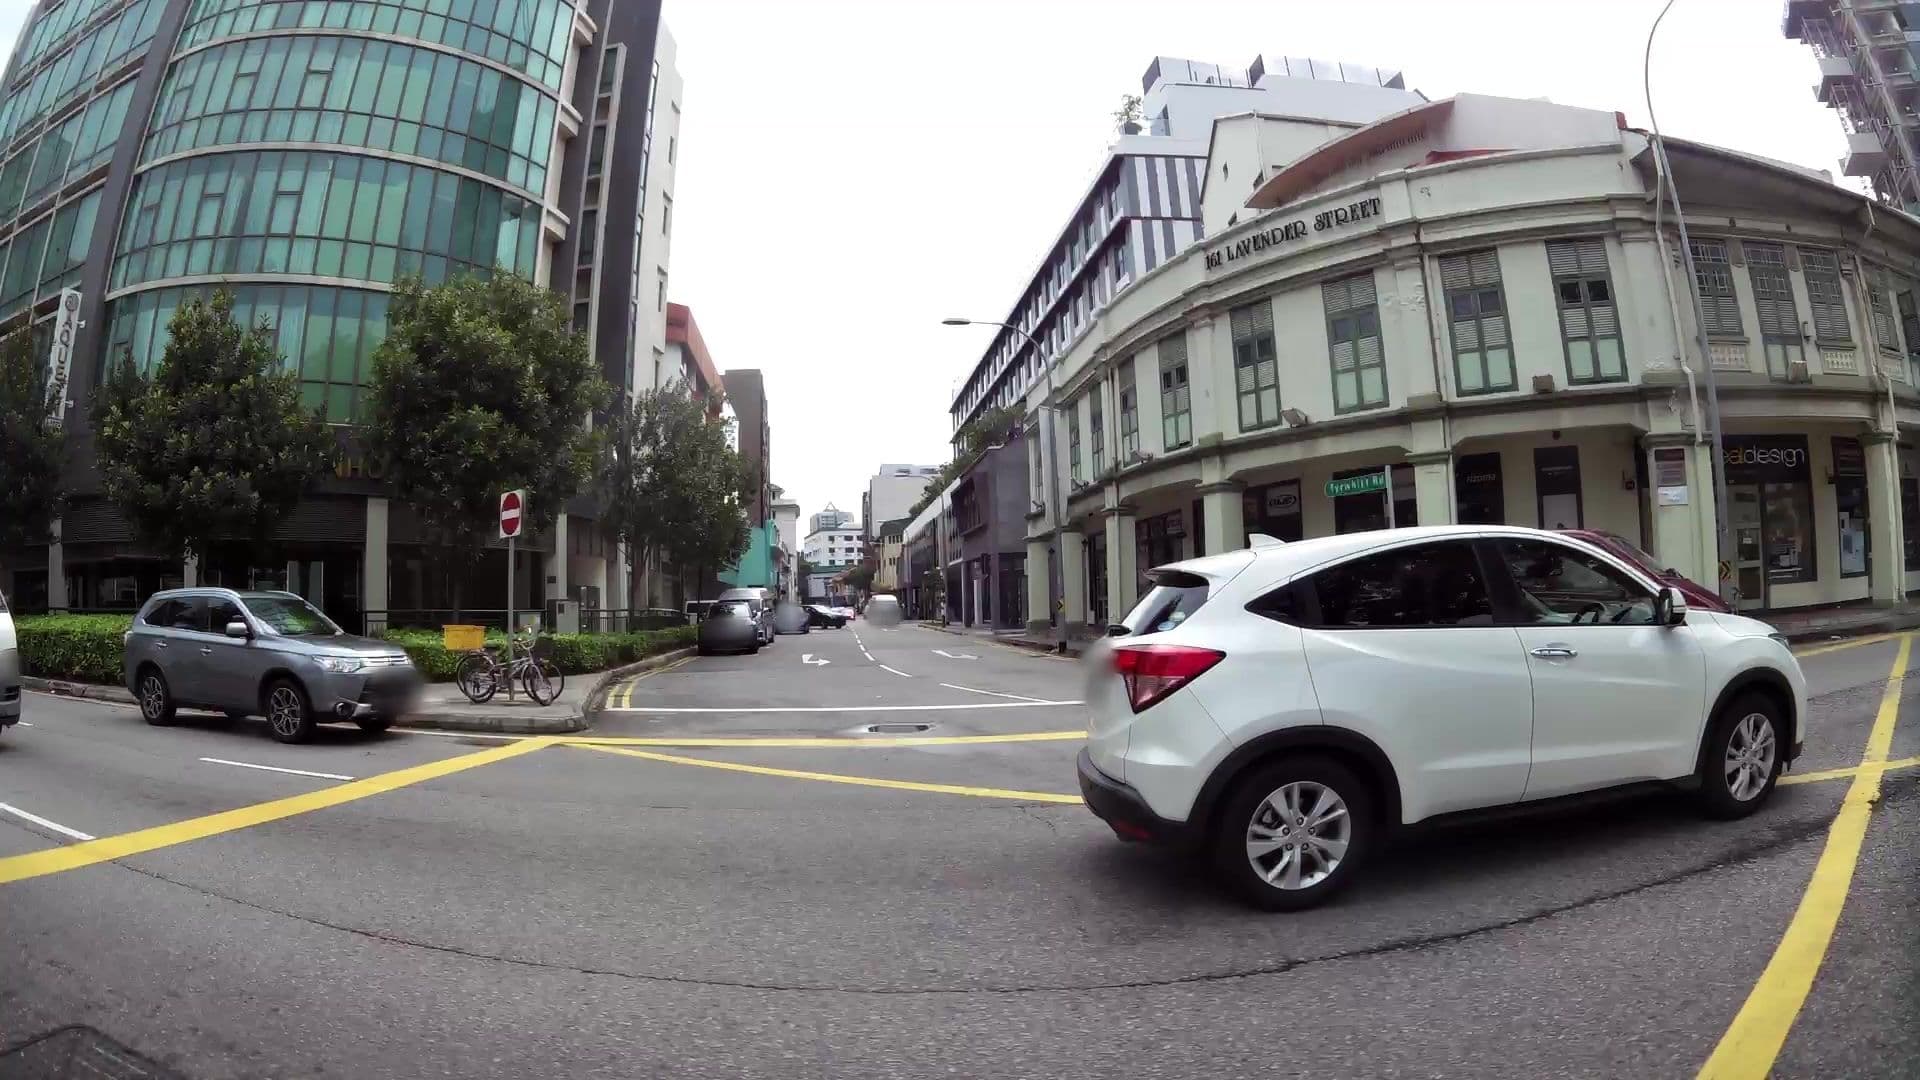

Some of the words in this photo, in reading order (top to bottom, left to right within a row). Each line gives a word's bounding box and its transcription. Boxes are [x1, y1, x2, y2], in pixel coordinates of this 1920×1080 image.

[1204, 249, 1222, 271] 161
[1226, 220, 1308, 262] LAVENDER
[1314, 198, 1381, 232] STREET
